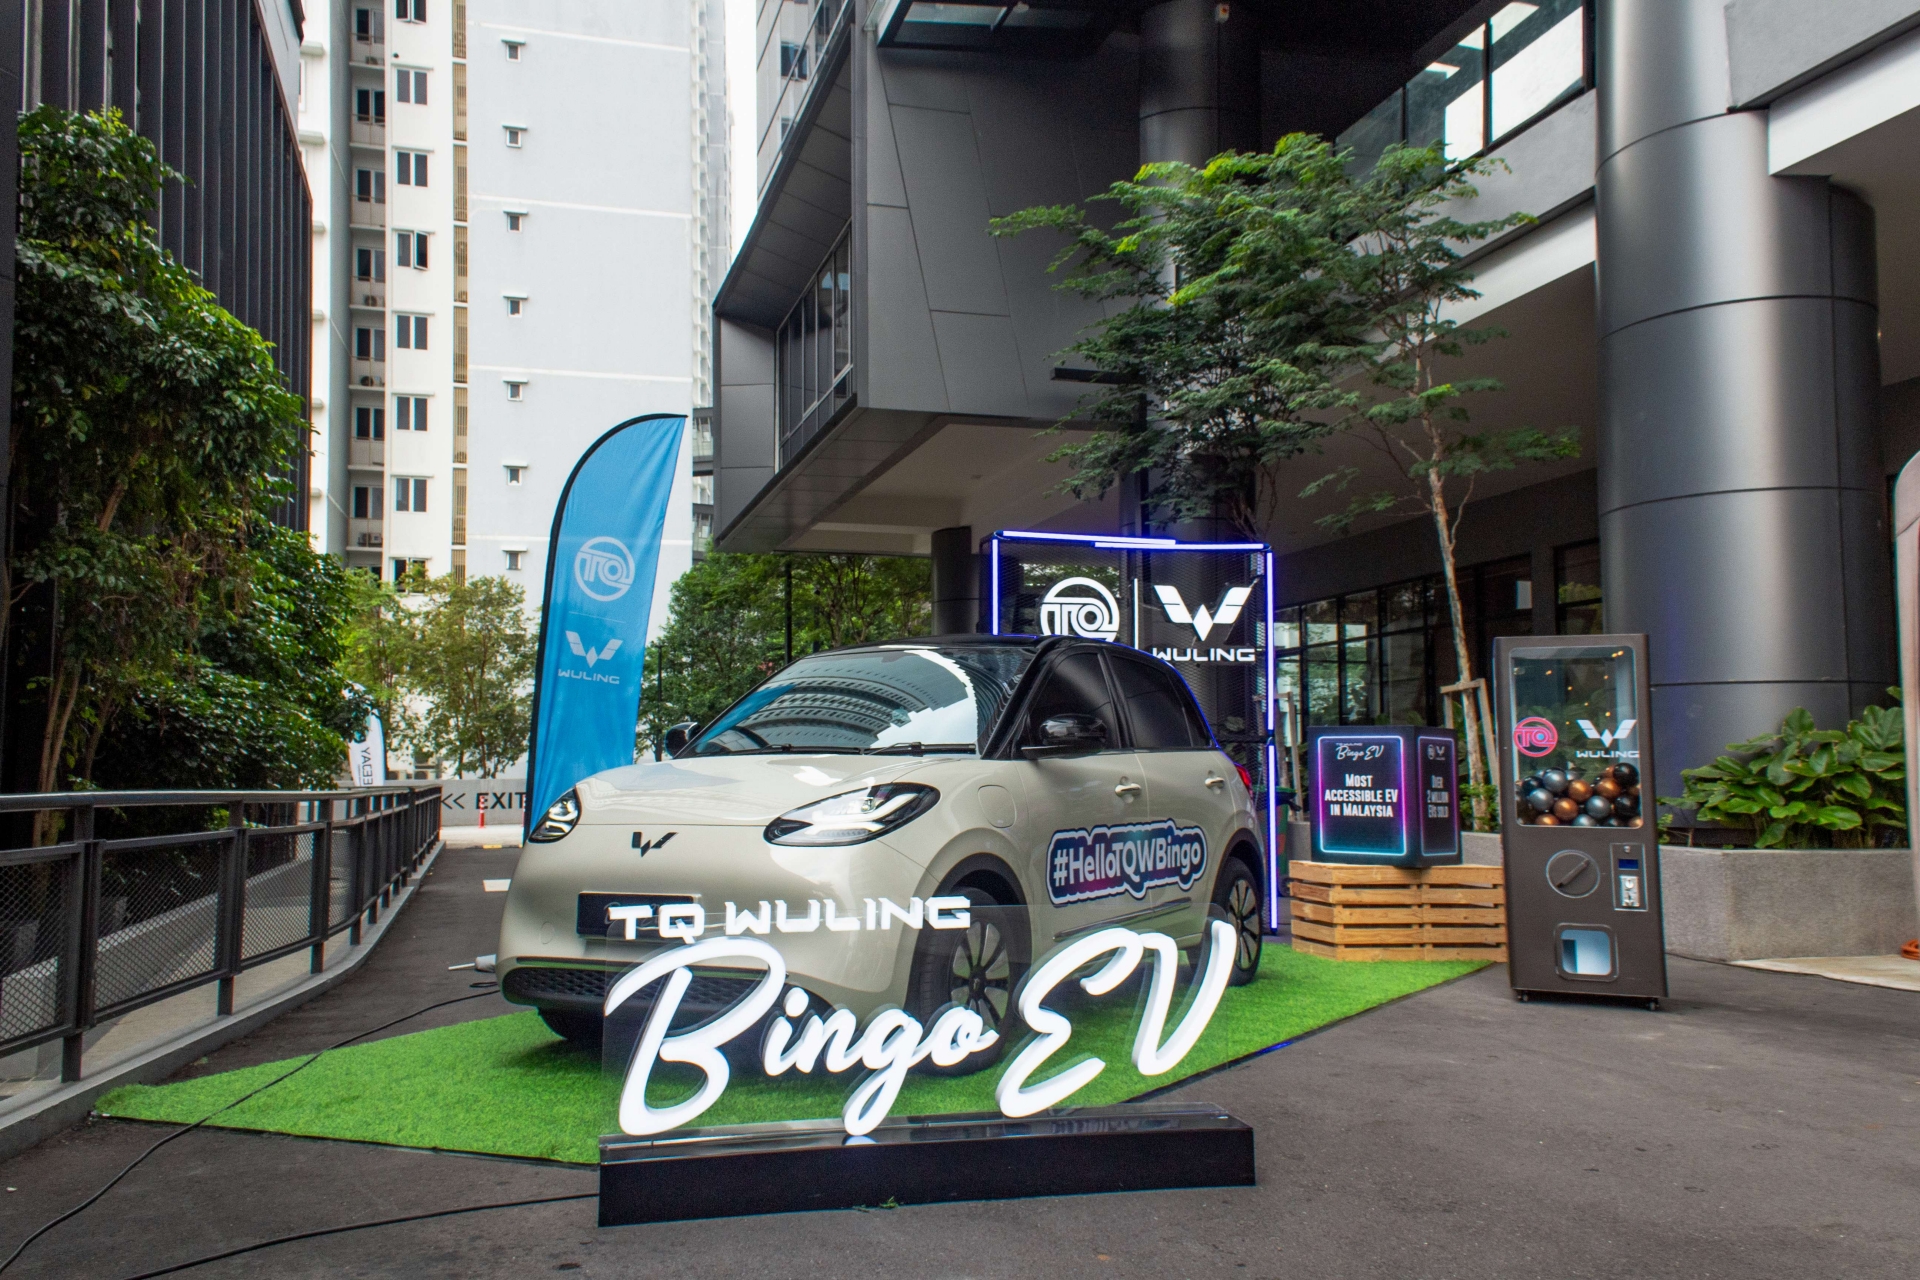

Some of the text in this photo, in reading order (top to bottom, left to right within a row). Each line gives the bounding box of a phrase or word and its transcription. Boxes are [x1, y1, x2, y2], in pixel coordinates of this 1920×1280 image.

[1153, 648, 1255, 662] WULING
[558, 669, 620, 685] WULING
[1364, 744, 1384, 760] EV
[1576, 750, 1640, 758] WULING
[1345, 774, 1373, 787] MOST
[476, 792, 526, 810] EXIT
[1324, 789, 1398, 803] ACCESSIBLE EV
[1330, 803, 1393, 817] IN MALAYSIA
[1053, 835, 1201, 887] #HelloTQWBingo
[608, 904, 705, 944] TQ
[725, 896, 971, 935] WULING
[604, 919, 1237, 1136] Bingo EV
